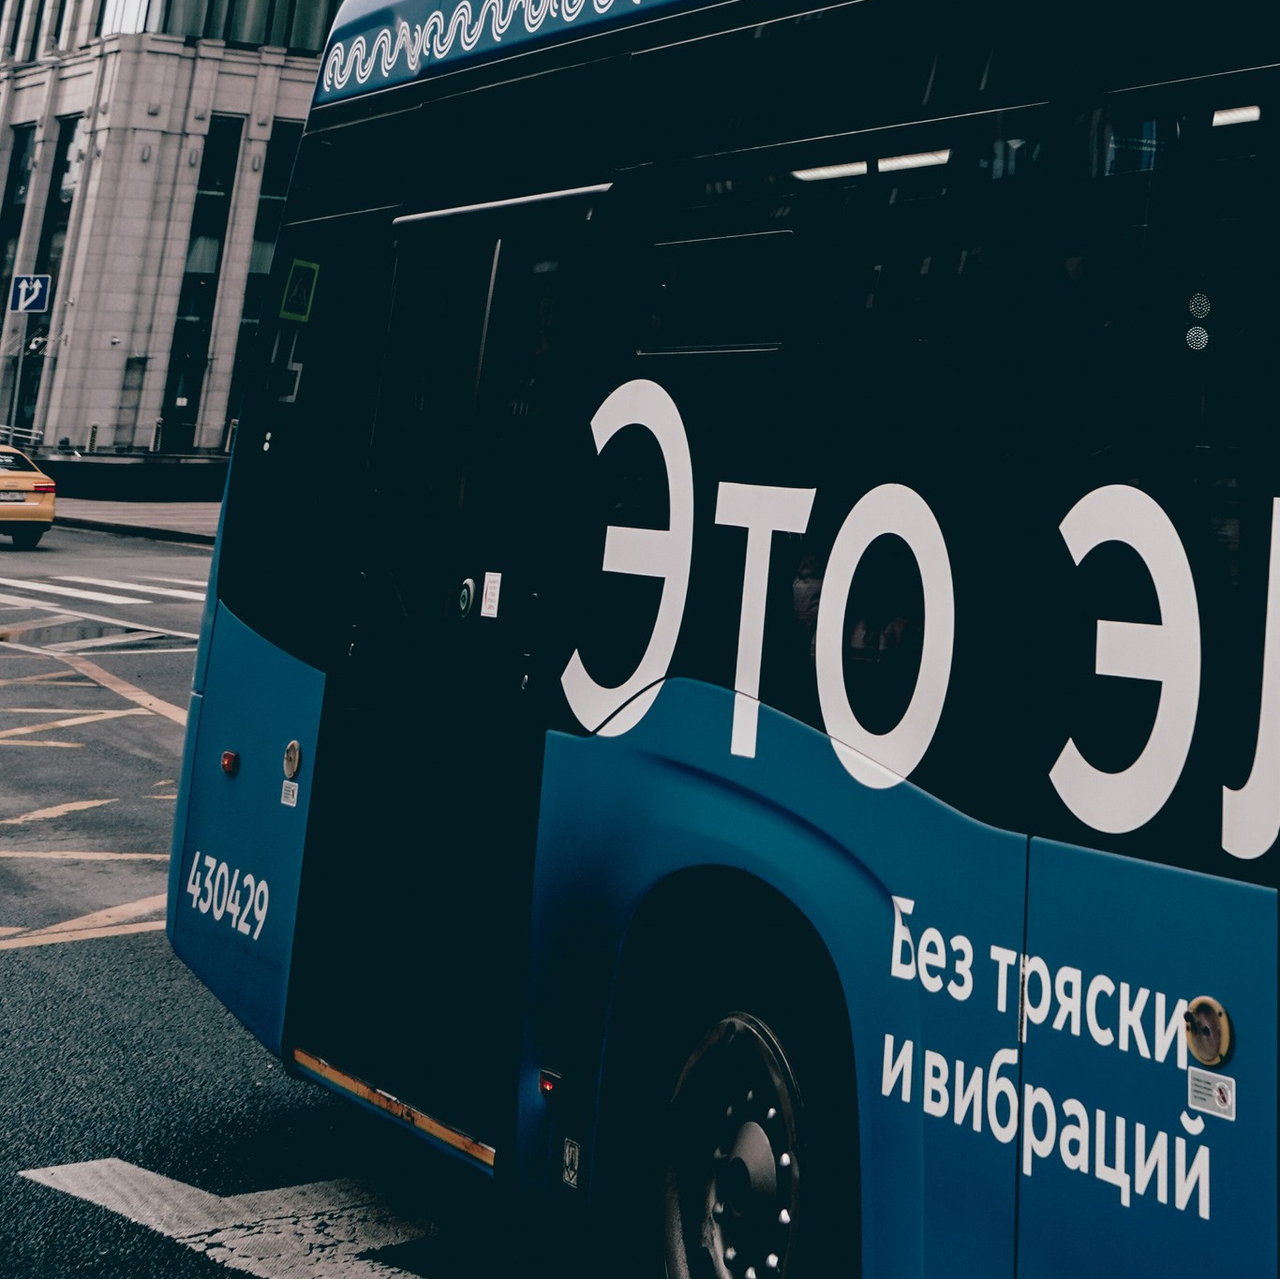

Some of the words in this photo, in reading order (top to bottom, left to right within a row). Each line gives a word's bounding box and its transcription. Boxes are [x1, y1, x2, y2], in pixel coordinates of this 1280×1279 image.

[560, 378, 955, 790] Это
[187, 851, 269, 941] 430429
[891, 895, 974, 1001] Без
[990, 944, 1189, 1070] тряски
[881, 1033, 914, 1103] и
[923, 1048, 1210, 1220] вибраций
